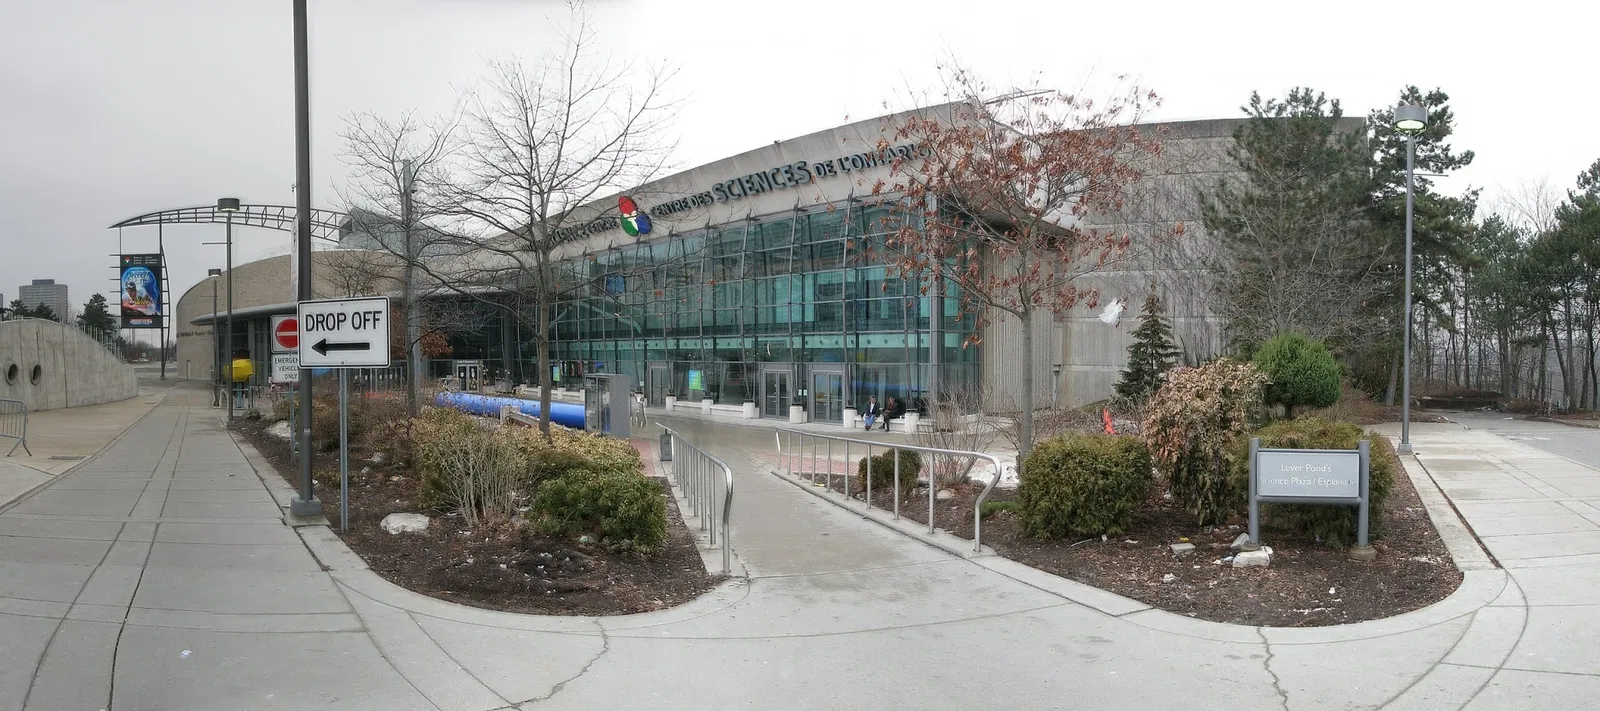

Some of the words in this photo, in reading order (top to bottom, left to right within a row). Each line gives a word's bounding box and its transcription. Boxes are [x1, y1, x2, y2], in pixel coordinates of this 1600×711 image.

[651, 197, 691, 217] CENTRE
[690, 191, 714, 209] DES
[712, 161, 812, 204] SCIENCES
[813, 160, 837, 179] DE
[305, 312, 347, 332] DROP
[351, 310, 382, 330] OFF
[1305, 463, 1332, 473] Pond's
[1260, 476, 1289, 485] Science
[1291, 477, 1311, 485] Plaza
